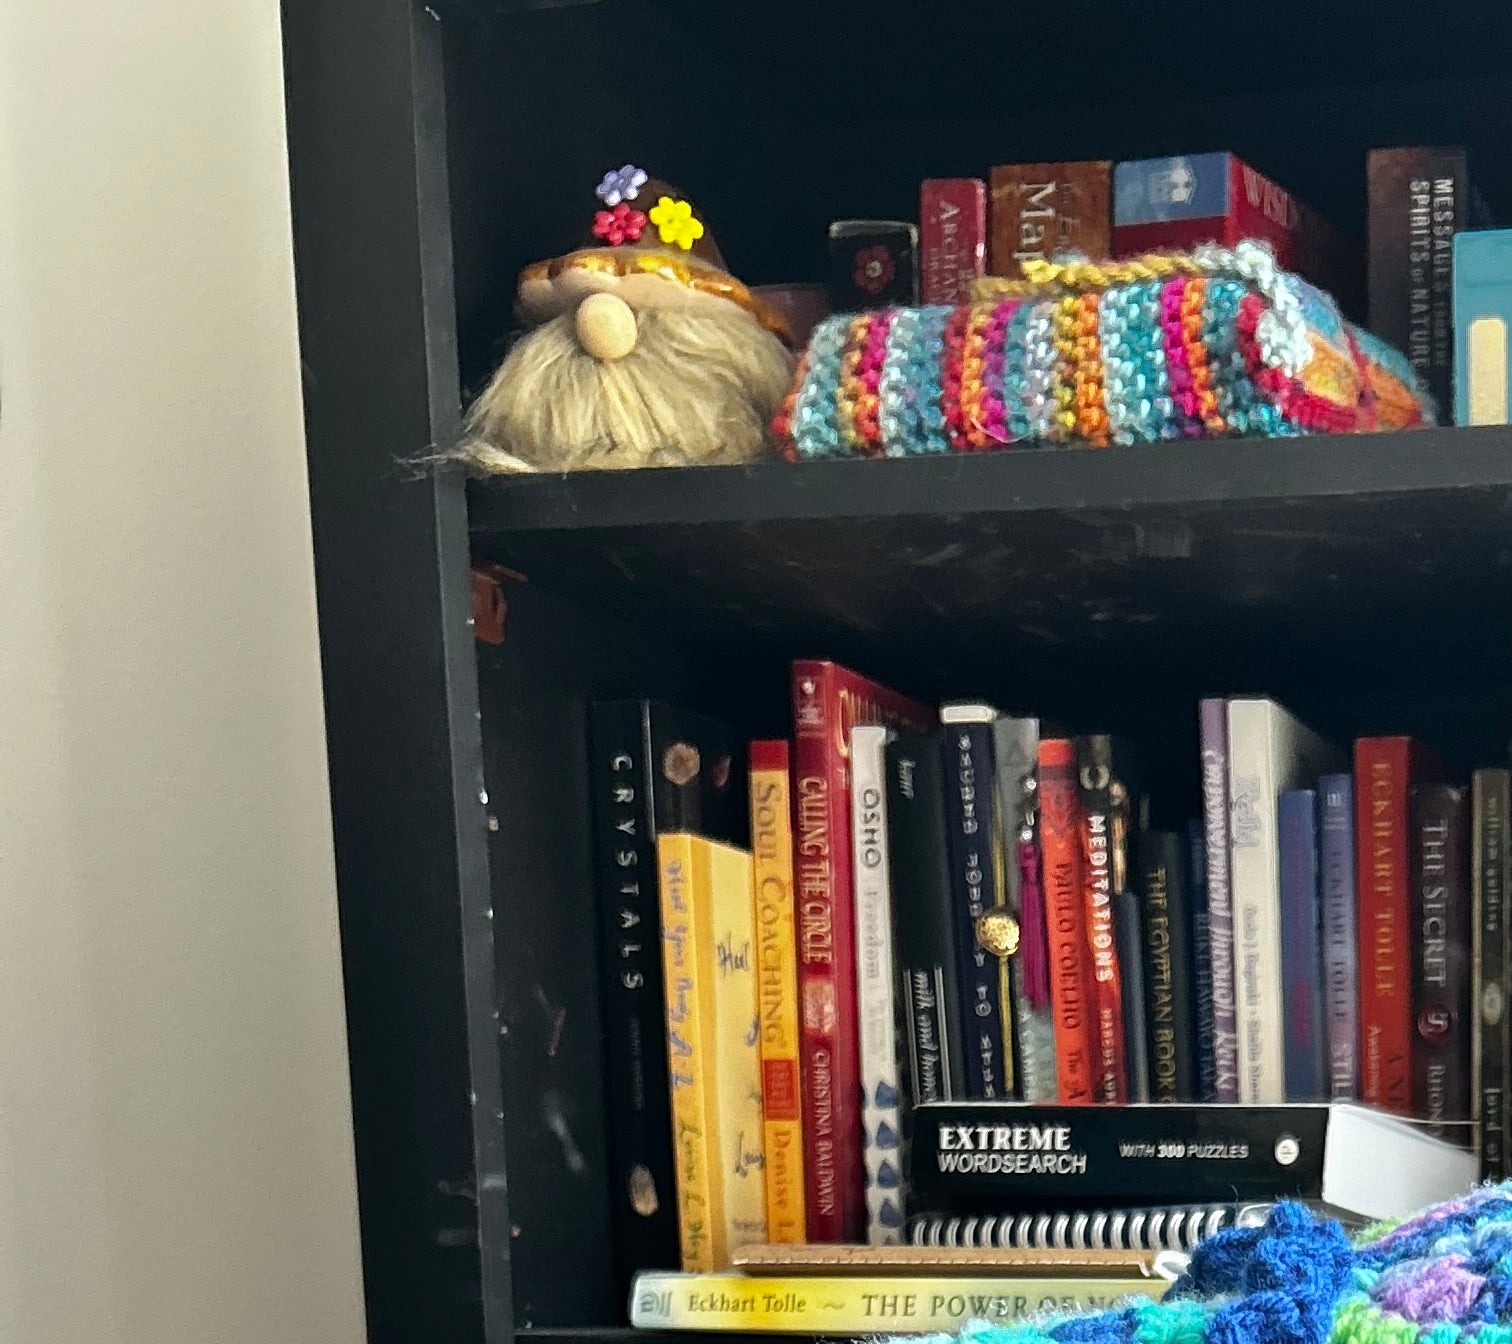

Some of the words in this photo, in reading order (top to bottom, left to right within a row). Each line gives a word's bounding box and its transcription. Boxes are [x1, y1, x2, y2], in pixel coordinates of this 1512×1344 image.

[1410, 179, 1431, 262] SPIRITS
[1410, 288, 1431, 368] NATURE
[757, 782, 782, 859] SOUL
[799, 775, 830, 856] CALLING
[861, 788, 881, 868] OSHO
[1370, 760, 1394, 897] ECKHART
[1422, 819, 1449, 877] THE
[611, 754, 644, 990] CRYSTALS
[800, 859, 832, 900] THE
[965, 852, 986, 968] JOURY
[1056, 862, 1079, 934] PAULO
[1087, 814, 1114, 983] MEDITATIONS
[1147, 867, 1168, 909] THE
[760, 875, 788, 1045] COACHING
[800, 901, 833, 964] CIRCLE
[1149, 915, 1174, 1022] EGYPTIAN
[1373, 908, 1396, 999] TOLLE
[1422, 886, 1449, 987] SECRET
[1059, 941, 1081, 1029] COELHO
[1100, 1008, 1114, 1067] MARCUS
[1156, 1027, 1176, 1090] BOOK
[812, 1049, 833, 1137] CHRISTINA
[769, 1130, 792, 1208] Denise
[938, 1153, 1088, 1174] WORDSEARCH
[939, 1125, 1072, 1151] EXTREME
[1119, 1143, 1155, 1158] WITH
[1186, 1143, 1249, 1159] PUZZLES
[814, 1139, 835, 1216] BALDWIN
[687, 1293, 756, 1313] Eckhart
[761, 1293, 807, 1313] Tolle
[862, 1293, 918, 1318] THE
[929, 1293, 1028, 1319] POWER
